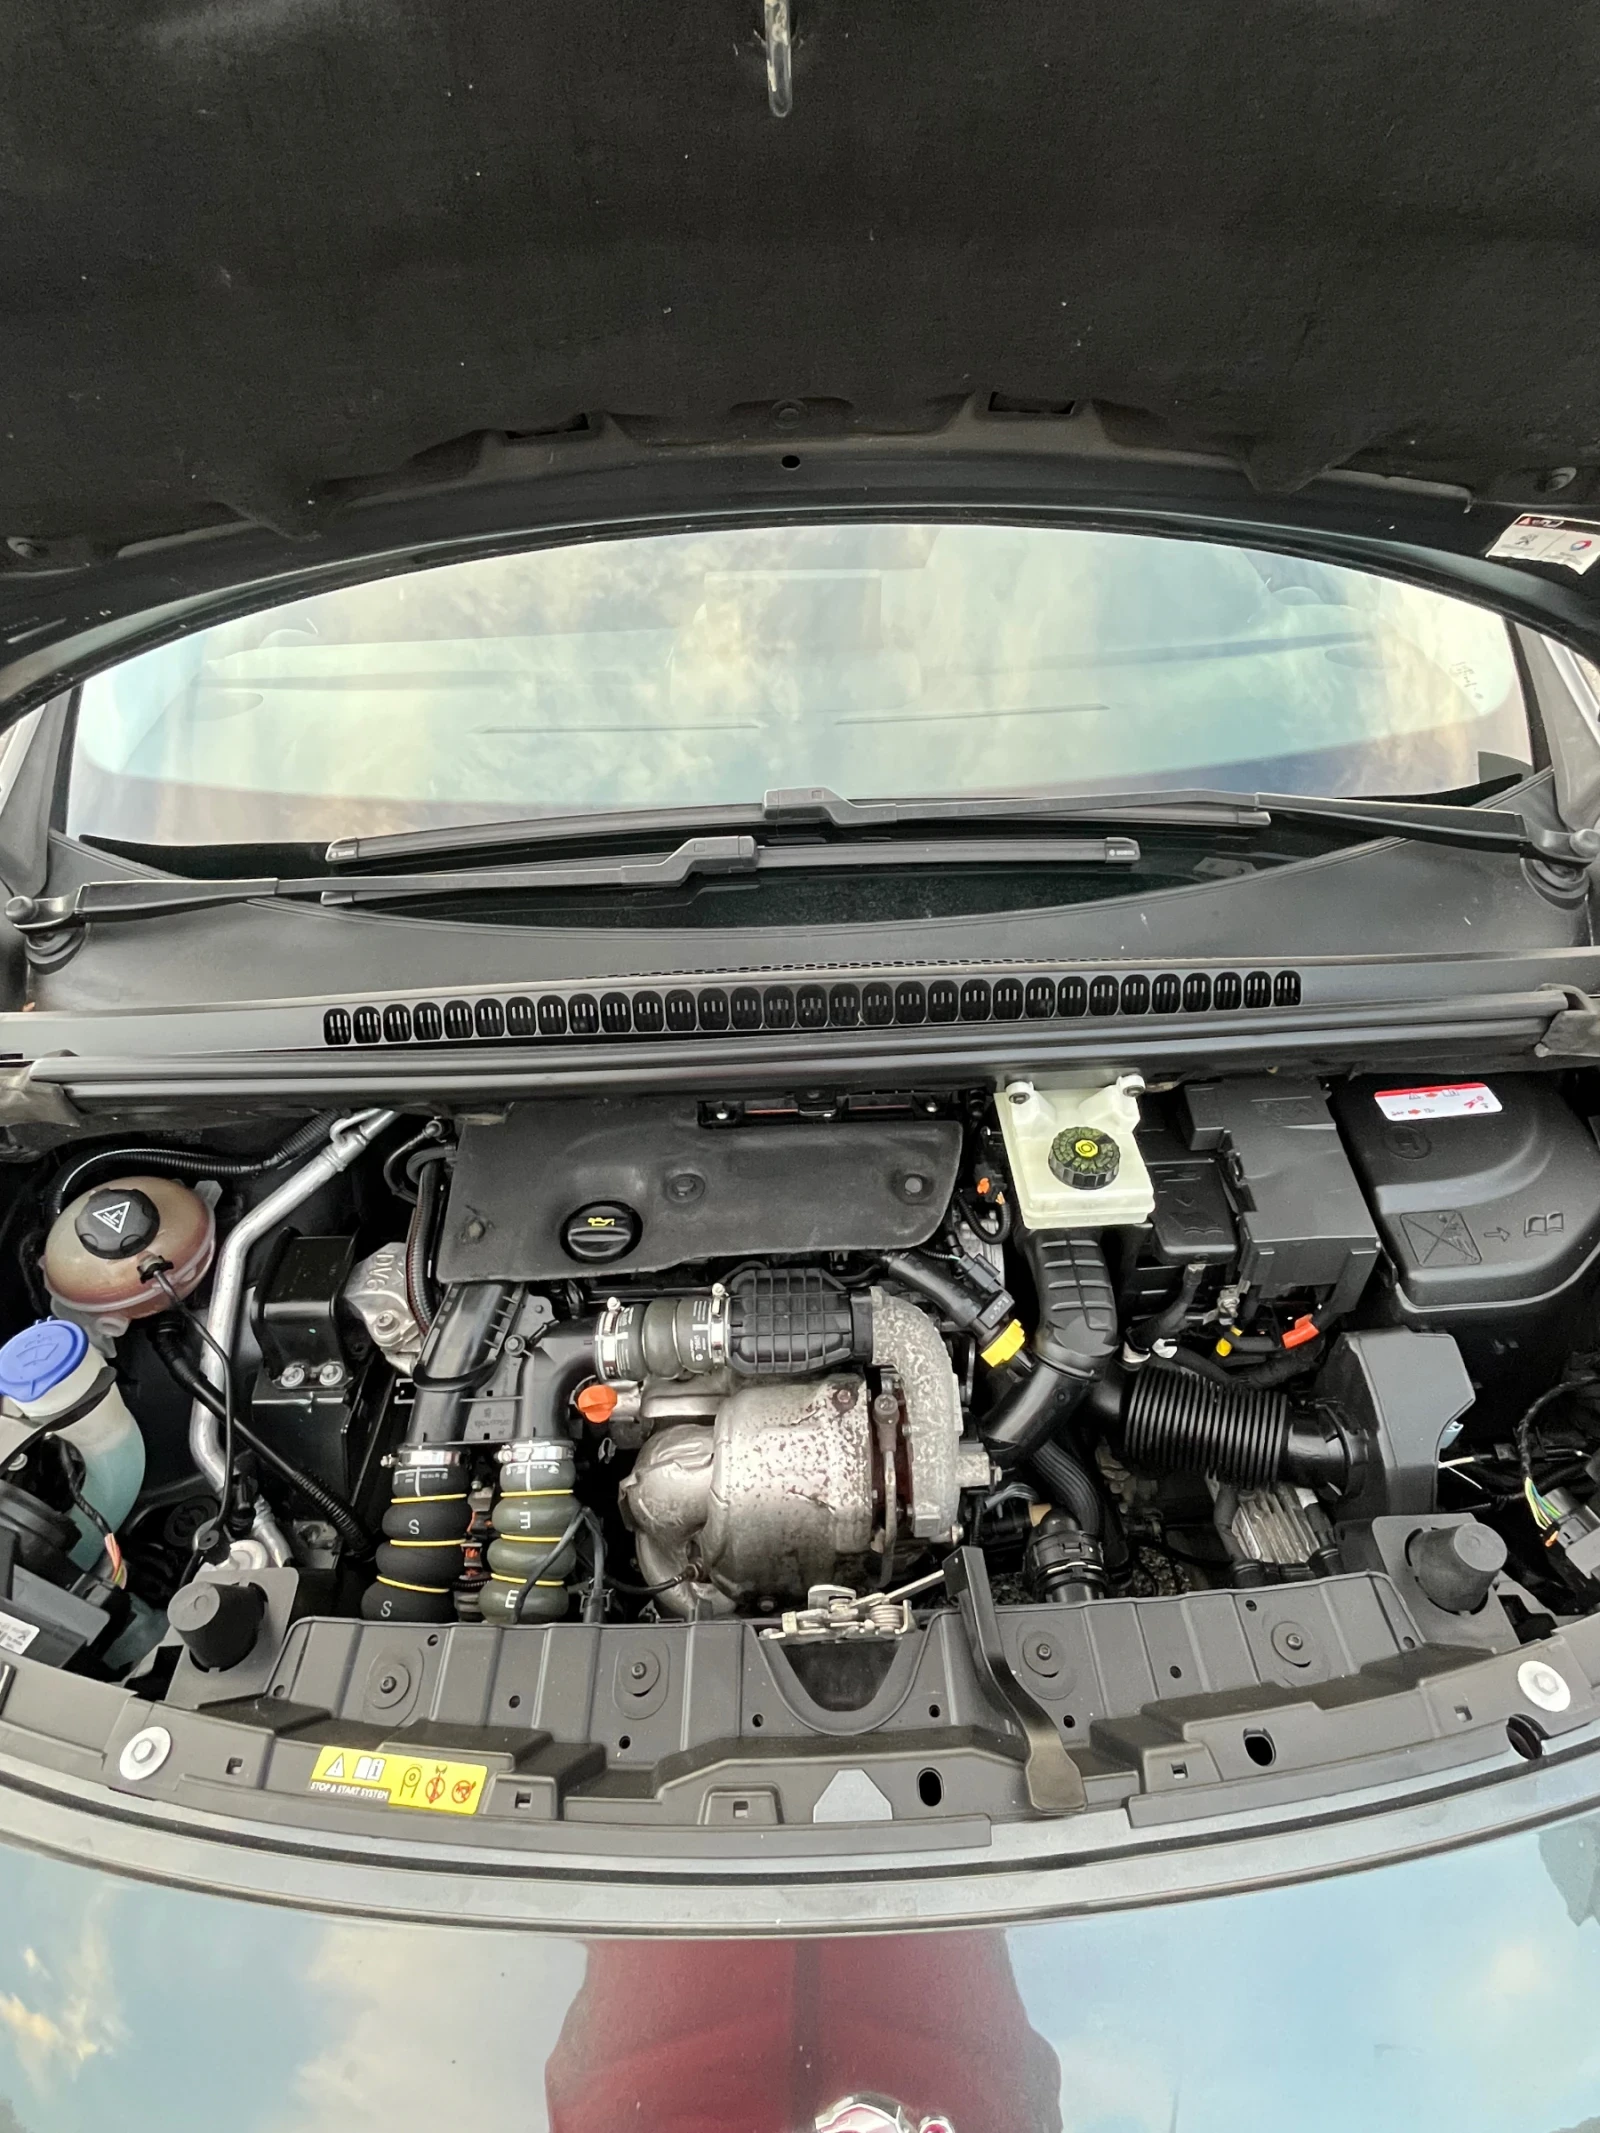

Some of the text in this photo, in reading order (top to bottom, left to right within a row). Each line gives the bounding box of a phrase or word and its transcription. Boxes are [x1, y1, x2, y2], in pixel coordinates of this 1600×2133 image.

[408, 1519, 420, 1535] S
[504, 1589, 519, 1609] E
[380, 1600, 392, 1618] S
[311, 1782, 331, 1792] STOP
[337, 1785, 359, 1796] START
[360, 1788, 389, 1800] SYSTEM
